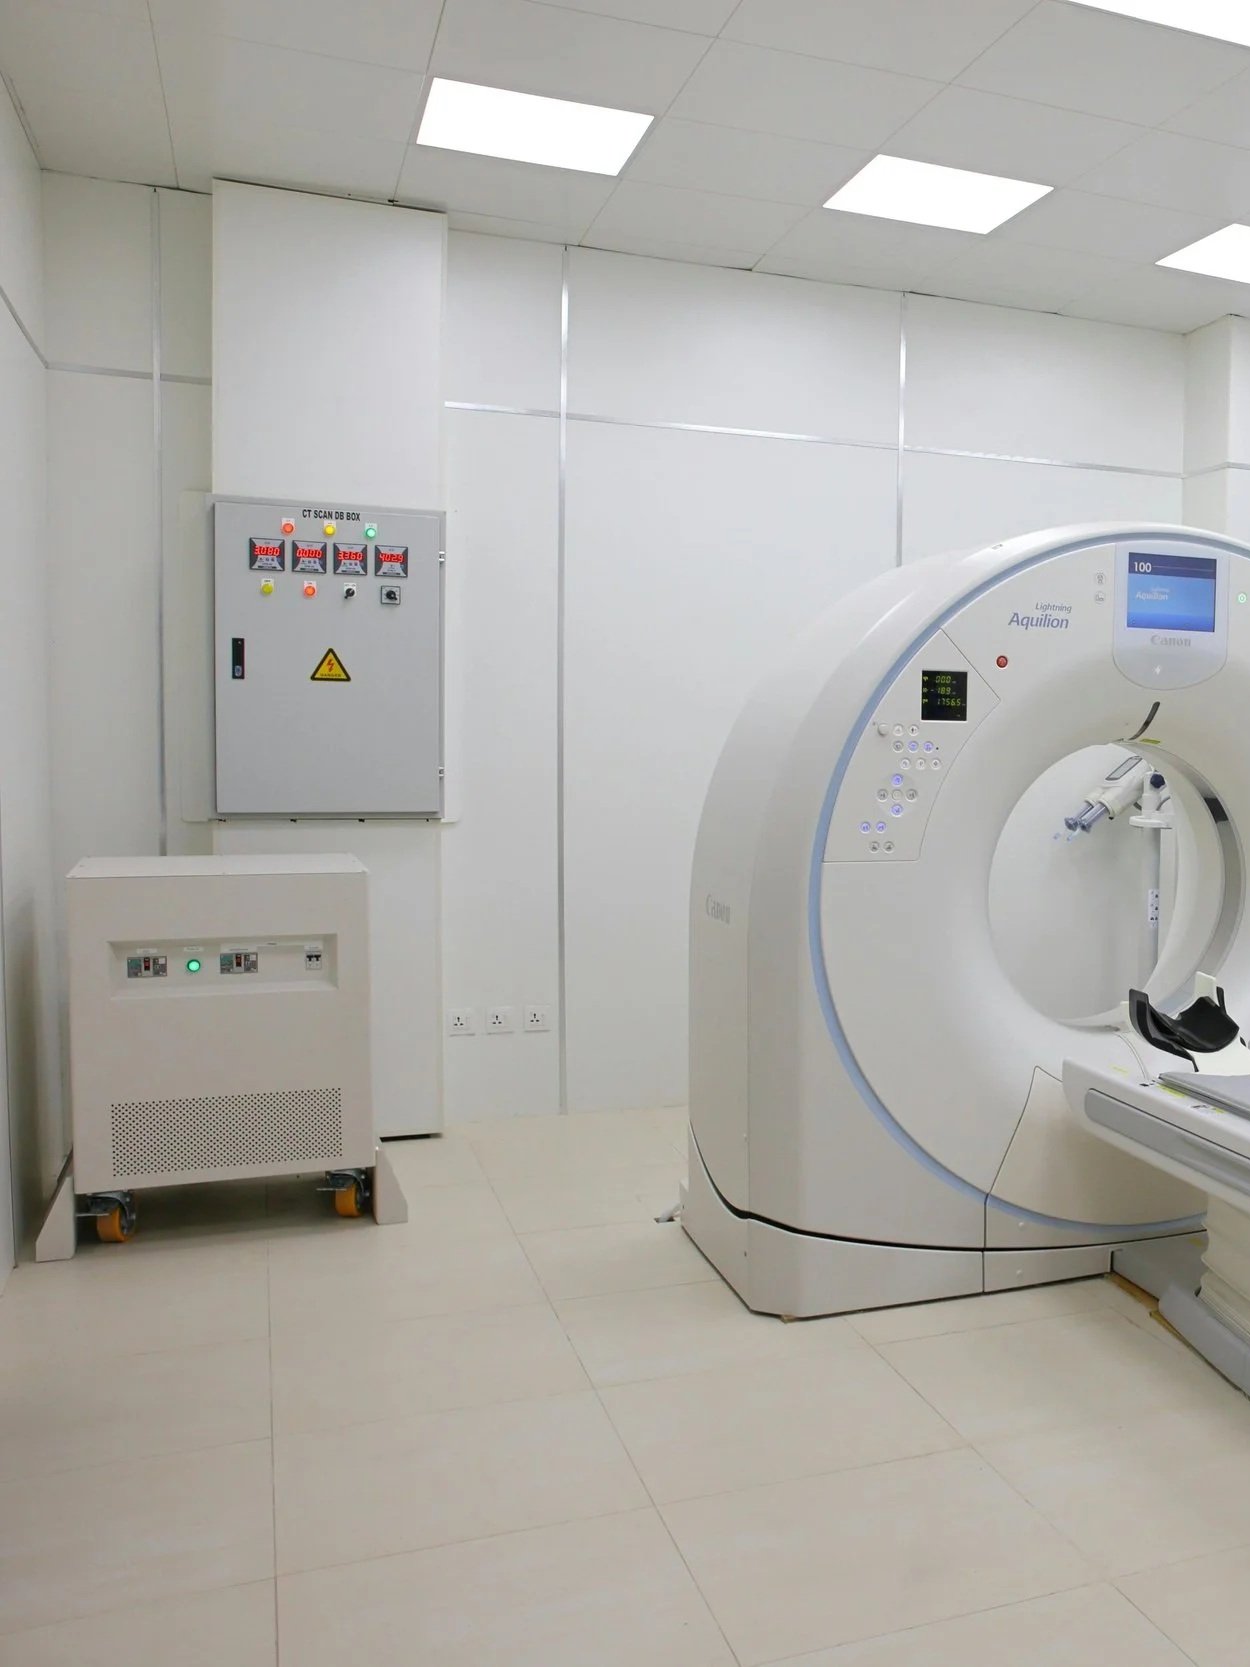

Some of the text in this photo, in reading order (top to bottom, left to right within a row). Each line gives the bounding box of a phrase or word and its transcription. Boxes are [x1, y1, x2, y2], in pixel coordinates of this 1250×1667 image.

[302, 509, 360, 521] CT SCAN DB BOX
[1134, 562, 1152, 573] 100
[1035, 602, 1072, 614] Lightning
[1008, 612, 1069, 630] Aquilion
[1151, 634, 1191, 648] Canon
